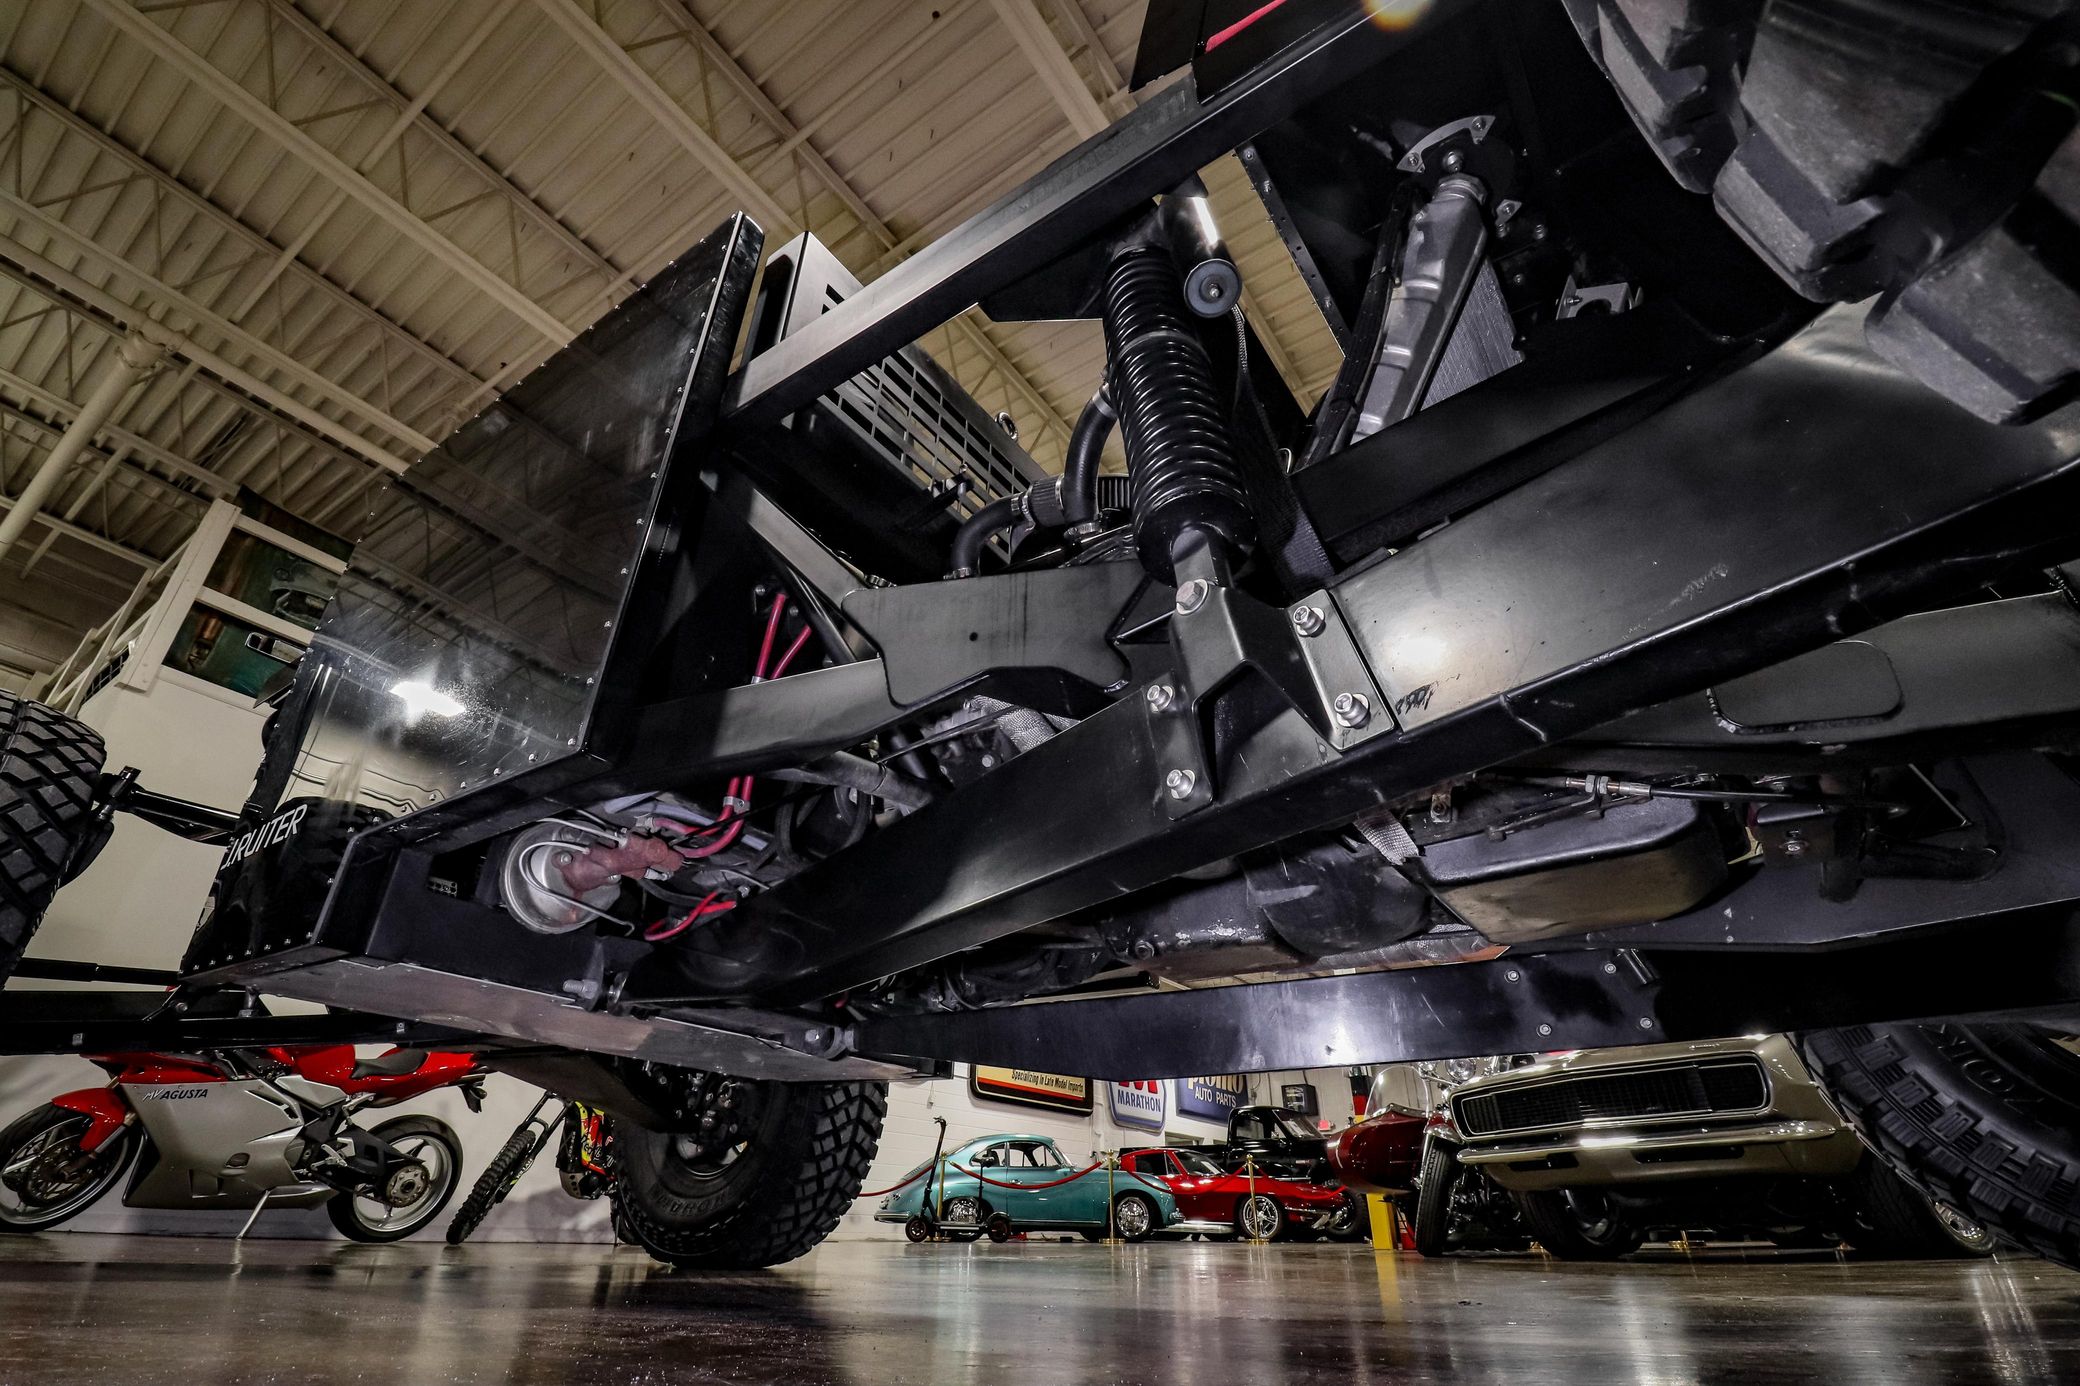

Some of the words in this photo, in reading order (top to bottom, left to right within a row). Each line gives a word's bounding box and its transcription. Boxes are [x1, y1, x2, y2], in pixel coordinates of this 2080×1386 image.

[1012, 1070, 1039, 1085] Specializing
[1055, 1077, 1068, 1089] Model
[160, 1089, 208, 1100] AGUSTA
[1117, 1089, 1161, 1113] MARATHON
[1194, 1086, 1213, 1102] AUTO
[1215, 1091, 1237, 1108] PARTS
